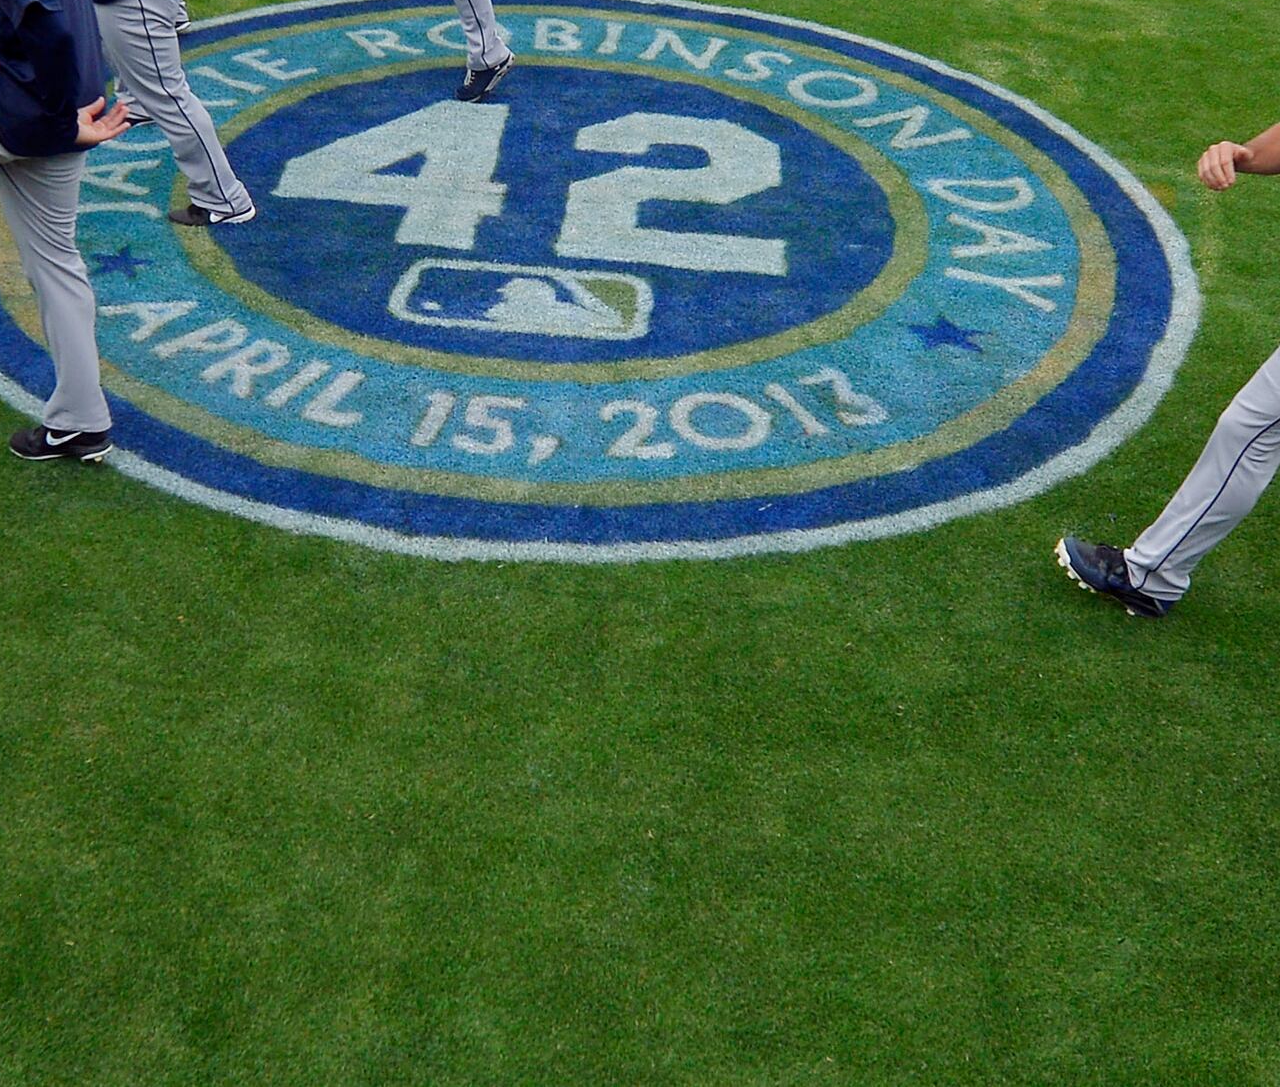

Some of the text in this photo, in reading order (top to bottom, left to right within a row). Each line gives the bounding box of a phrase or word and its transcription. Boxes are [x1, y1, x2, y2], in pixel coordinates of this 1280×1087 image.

[271, 99, 788, 277] 42
[346, 16, 977, 151] ROBINSON
[927, 174, 1064, 313] DAY
[99, 299, 889, 464] APRIL 15, 2013
